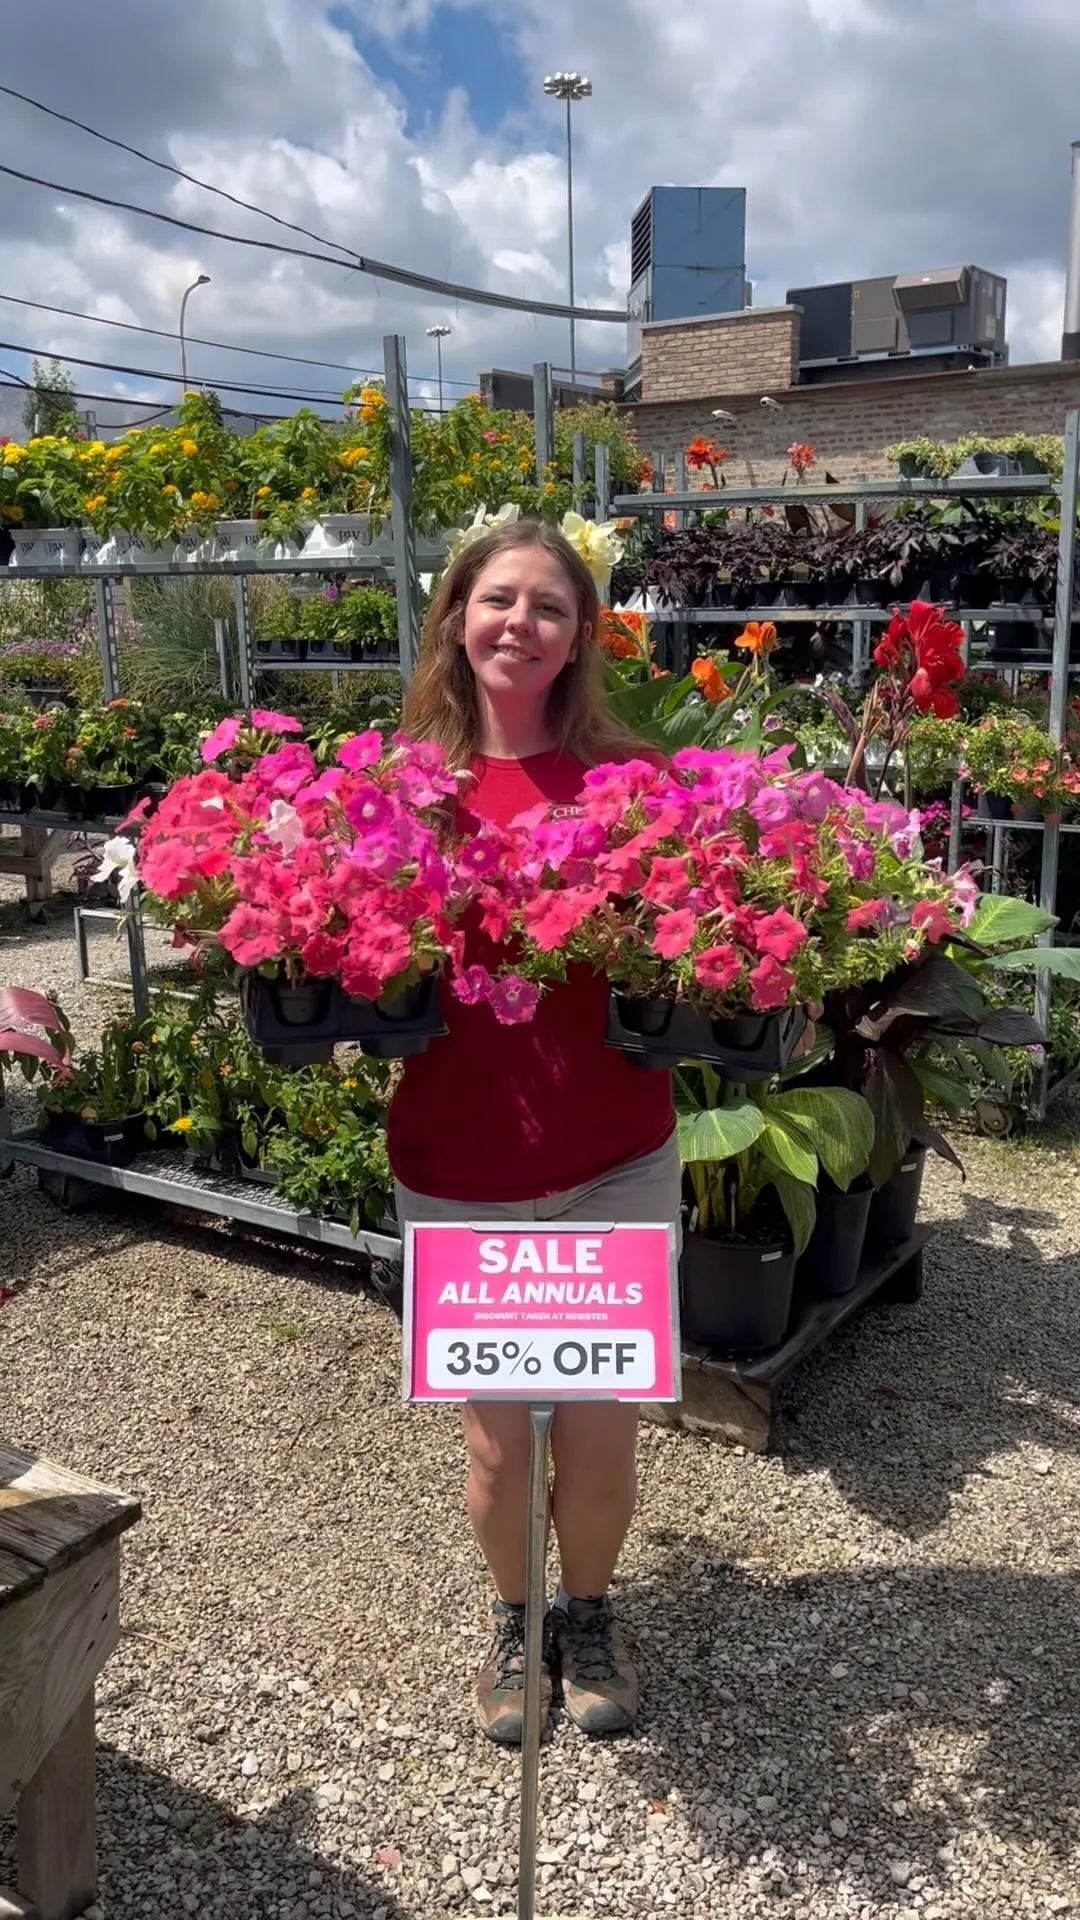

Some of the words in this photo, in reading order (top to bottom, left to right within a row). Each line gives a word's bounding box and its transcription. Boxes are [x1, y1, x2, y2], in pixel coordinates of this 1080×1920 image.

[478, 1239, 603, 1274] SALE
[438, 1282, 494, 1304] ALL
[501, 1282, 643, 1305] ANNUALS
[474, 1312, 518, 1321] DISCOUNT
[520, 1312, 550, 1321] TAKEN
[551, 1312, 564, 1321] AT
[565, 1312, 608, 1321] REGISTER
[446, 1341, 542, 1376] 35%
[553, 1341, 637, 1376] OFF
